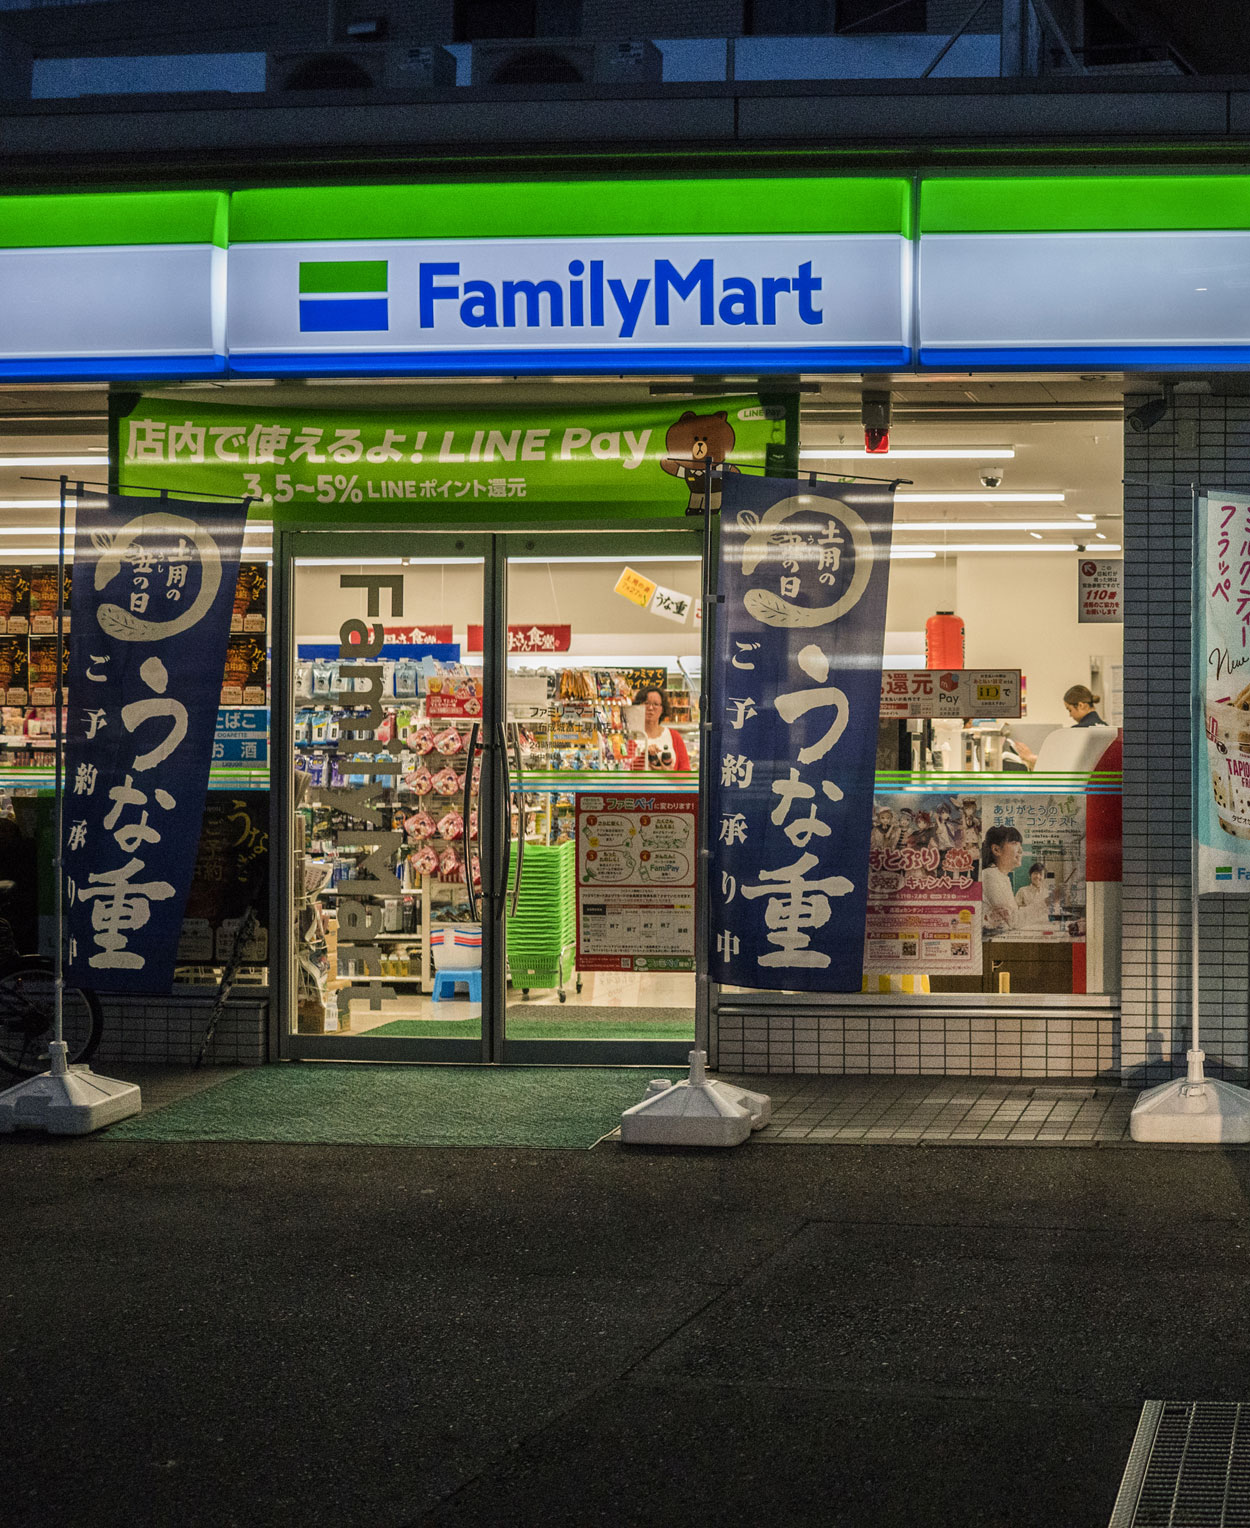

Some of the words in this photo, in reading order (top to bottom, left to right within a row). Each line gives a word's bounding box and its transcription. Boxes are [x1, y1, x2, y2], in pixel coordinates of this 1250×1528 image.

[419, 259, 823, 338] FamilyMart
[127, 419, 428, 465] 店内で使えるよ!
[439, 429, 549, 463] LINE
[560, 427, 652, 470] Pay
[166, 538, 194, 602] 土用の
[816, 520, 845, 586] 土用の
[1212, 505, 1236, 603] フラッペ
[656, 593, 688, 617] うな重
[529, 707, 602, 718] ファミリーマート
[939, 693, 960, 704] Pay
[78, 656, 189, 970] うな重
[716, 640, 761, 963] ご予約承り中
[740, 643, 855, 968] うな重
[993, 804, 1058, 816] ありがとうの
